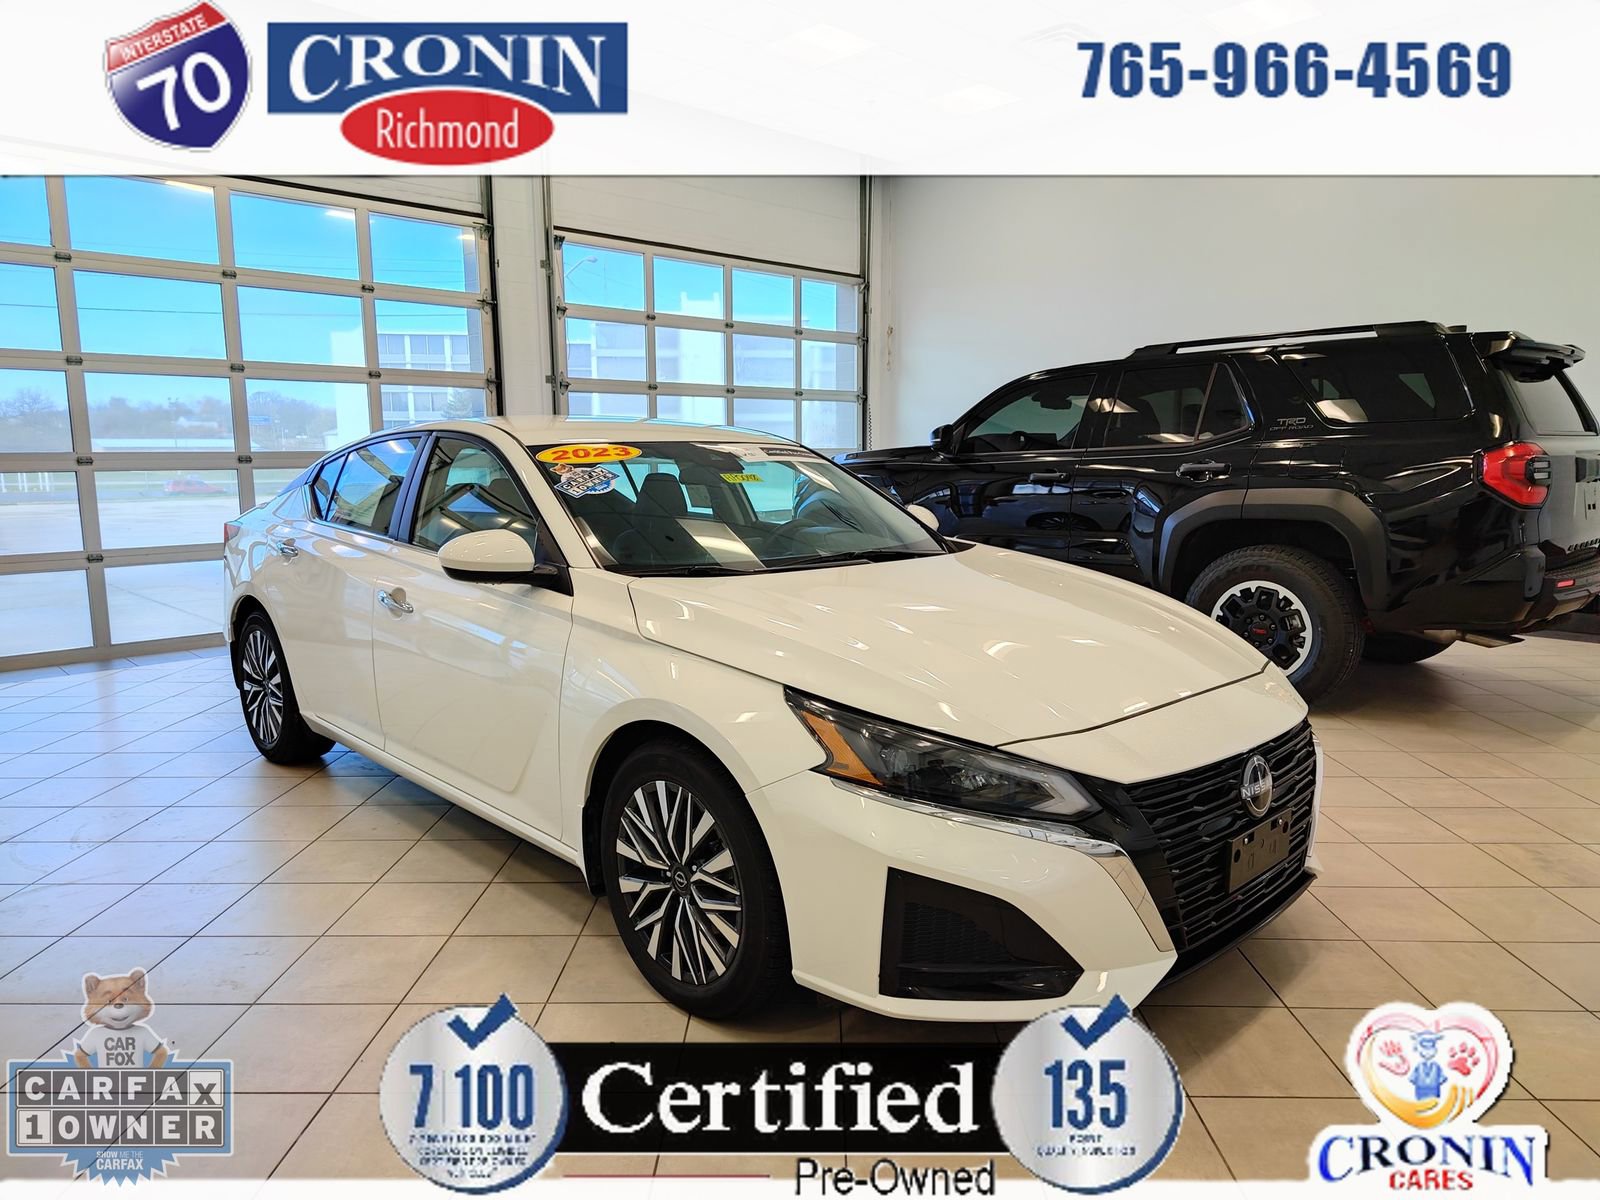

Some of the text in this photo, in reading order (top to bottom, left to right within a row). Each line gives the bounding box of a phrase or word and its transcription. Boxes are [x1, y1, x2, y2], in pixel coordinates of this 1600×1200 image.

[1277, 417, 1307, 426] TRD
[551, 446, 632, 461] 2023
[1242, 779, 1270, 798] NISS
